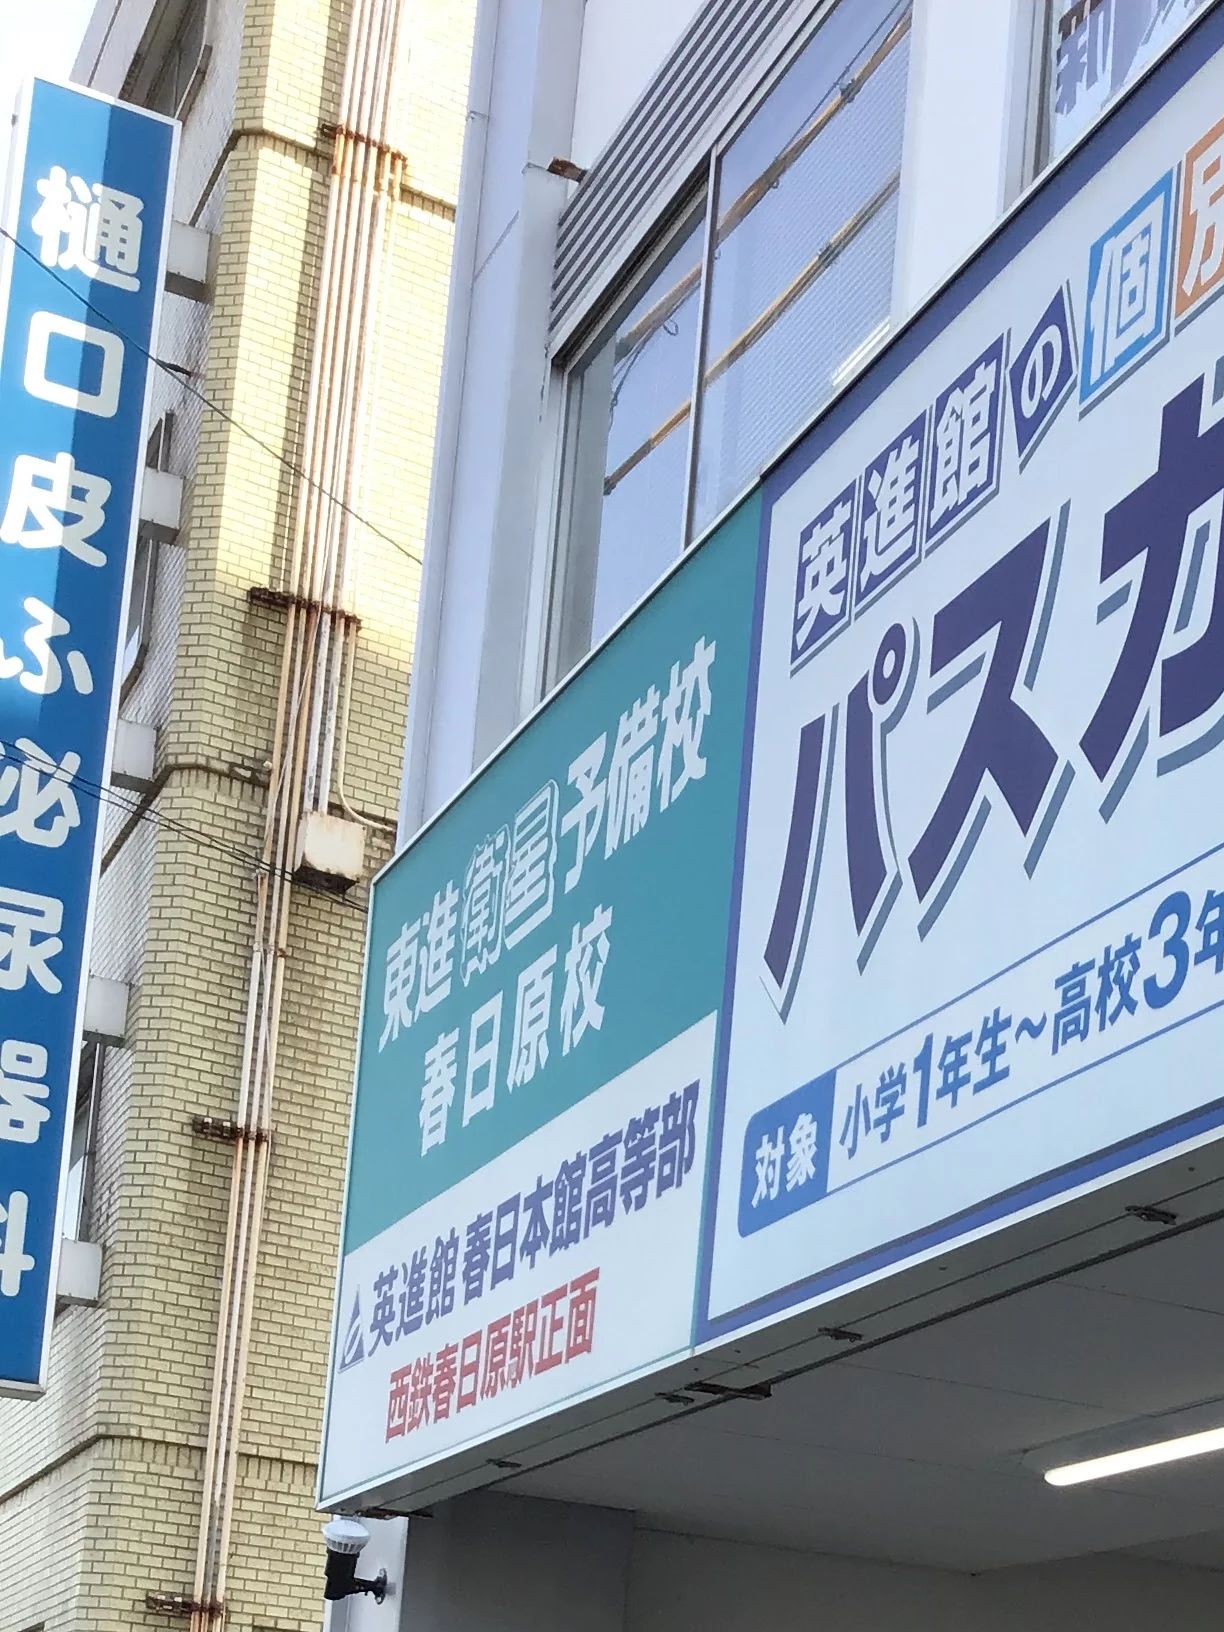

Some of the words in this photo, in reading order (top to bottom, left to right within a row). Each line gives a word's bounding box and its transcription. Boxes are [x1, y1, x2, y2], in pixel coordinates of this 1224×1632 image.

[377, 637, 717, 1052] 東進衛星予備校
[419, 905, 613, 1159] 春日原校
[751, 1113, 818, 1208] 対象
[384, 1267, 602, 1445] 西鉄春日原駅正面
